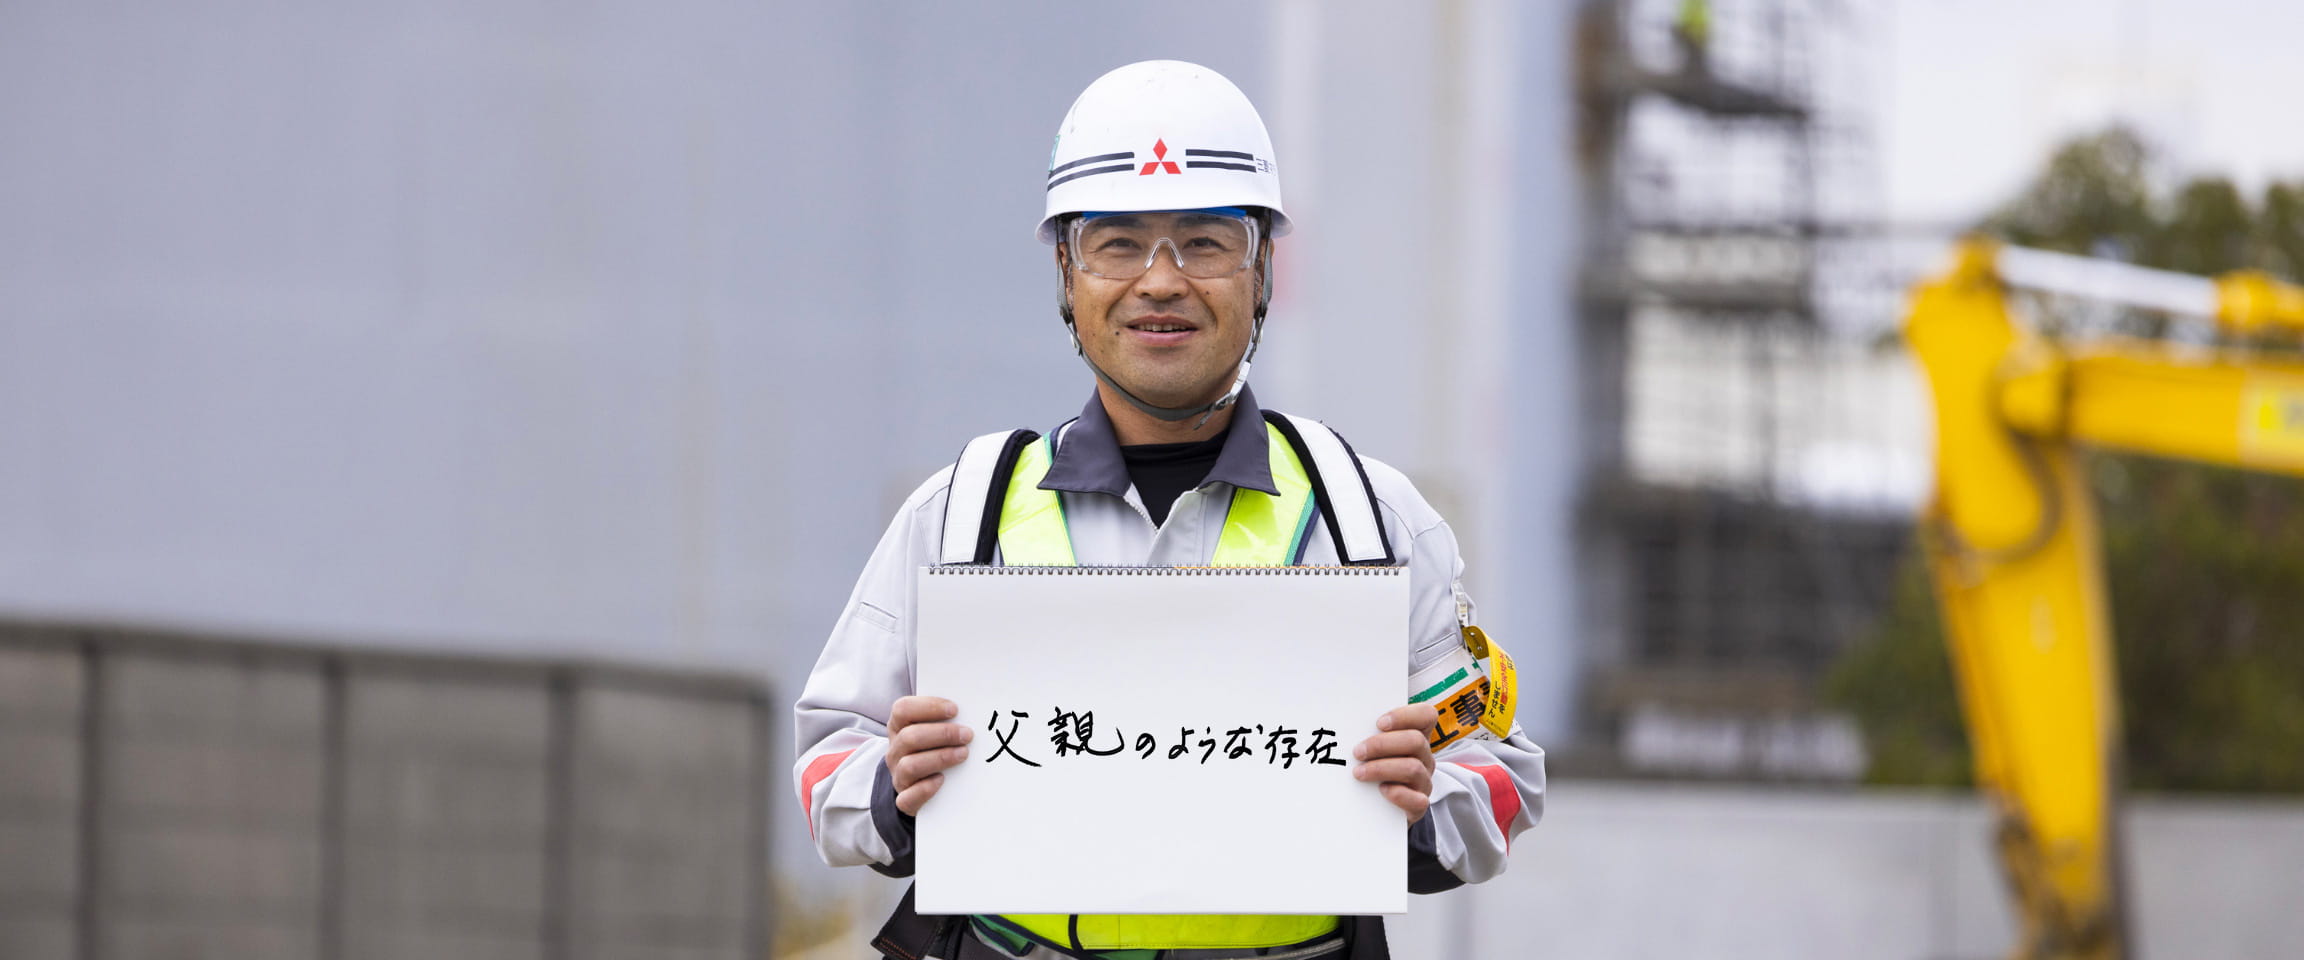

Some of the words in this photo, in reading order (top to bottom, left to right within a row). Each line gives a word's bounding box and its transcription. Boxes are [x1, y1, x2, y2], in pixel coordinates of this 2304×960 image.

[985, 706, 1347, 769] 父親のような存在
